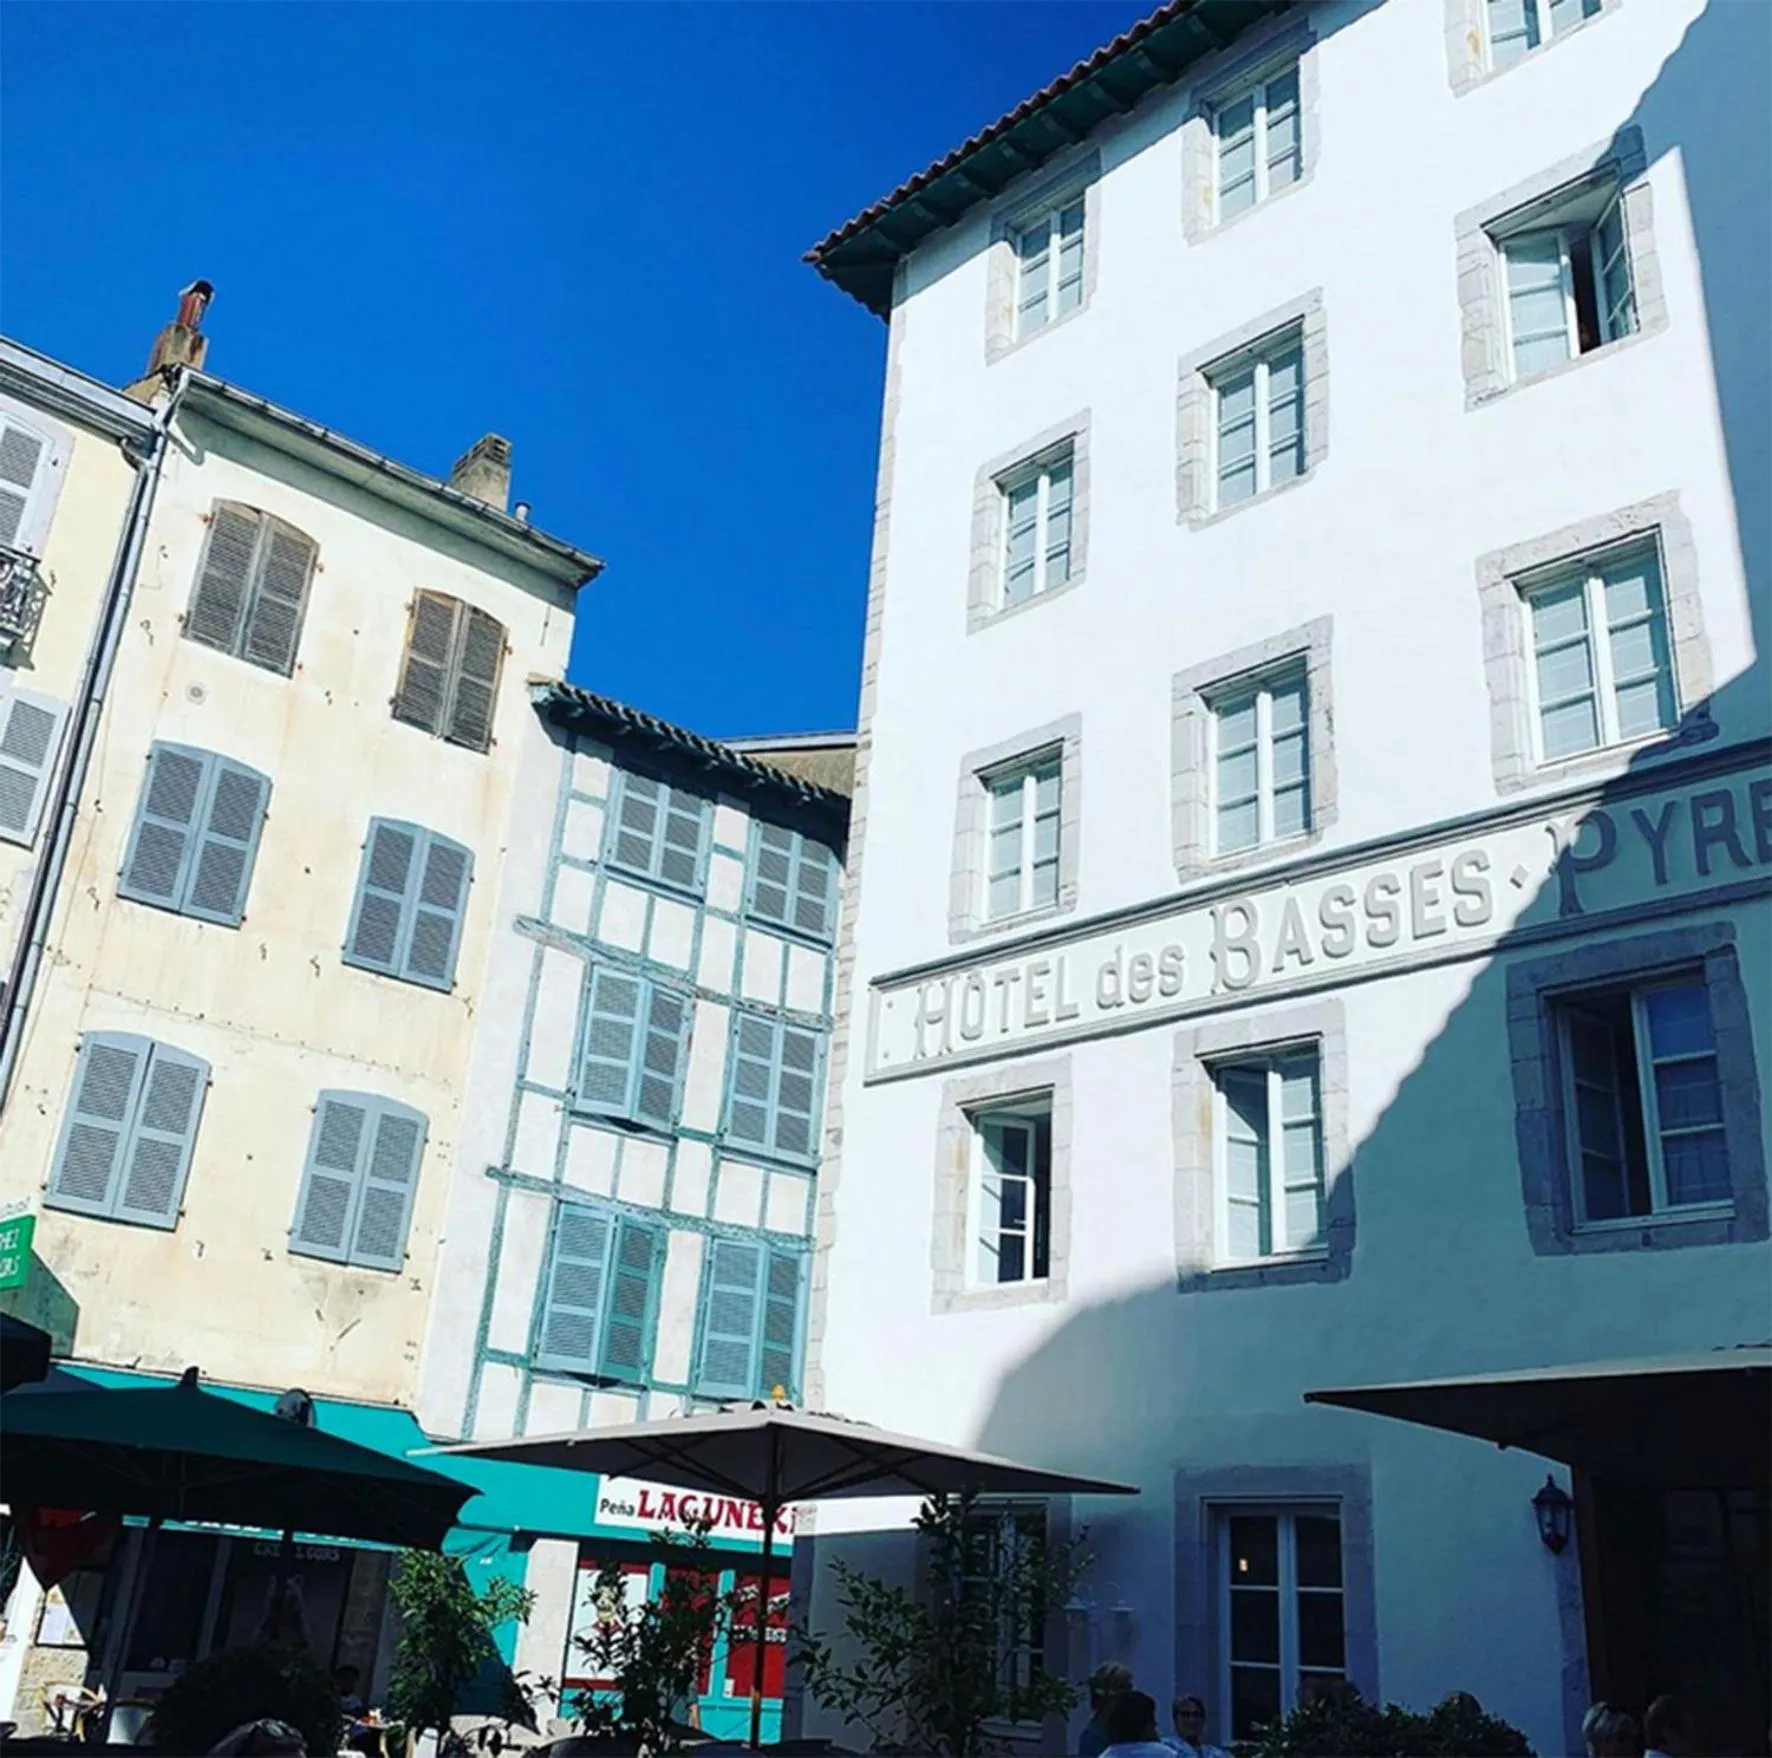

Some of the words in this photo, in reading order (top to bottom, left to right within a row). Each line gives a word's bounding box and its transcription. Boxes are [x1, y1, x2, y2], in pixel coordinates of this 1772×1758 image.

[913, 961, 1080, 1061] HÔTEL
[1096, 944, 1185, 1009] des
[1210, 848, 1495, 996] BASSES
[600, 1498, 635, 1518] Peña
